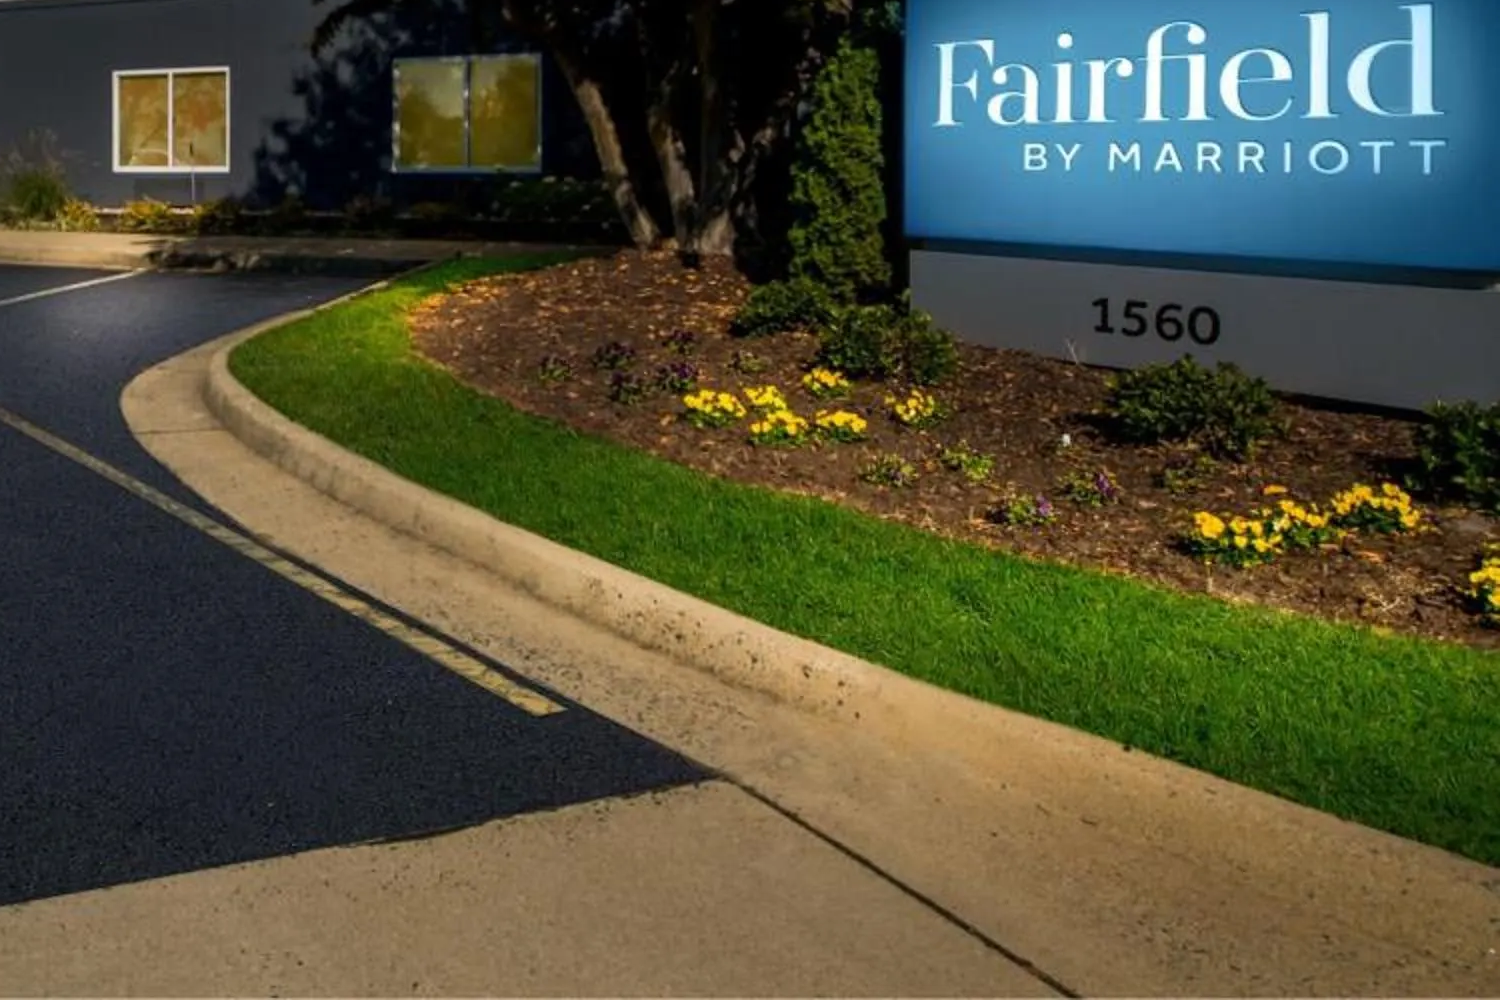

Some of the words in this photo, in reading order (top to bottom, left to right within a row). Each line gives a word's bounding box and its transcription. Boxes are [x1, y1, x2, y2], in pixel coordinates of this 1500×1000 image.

[932, 3, 1444, 127] Fairfield
[1023, 142, 1081, 171] BY
[1107, 140, 1446, 174] MARRIOTT
[1092, 297, 1221, 346] 1560
